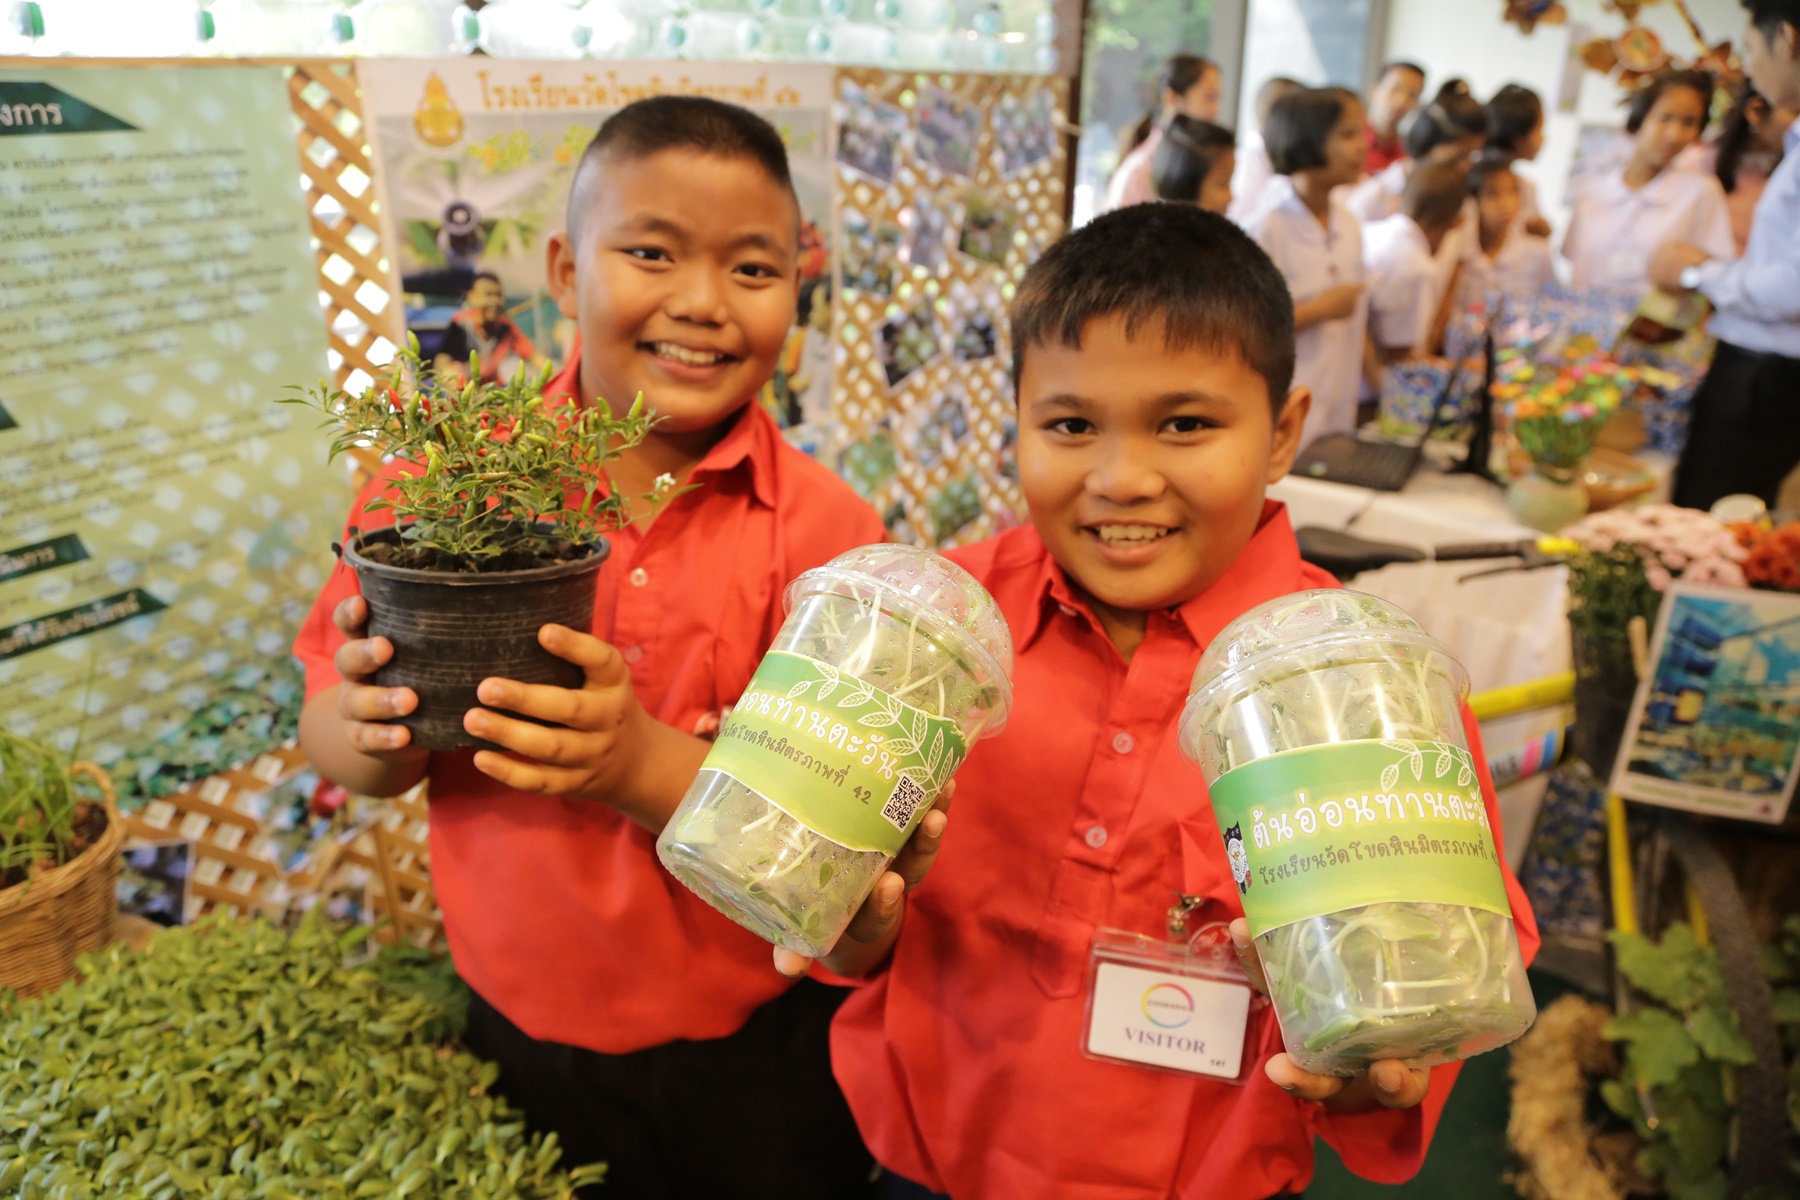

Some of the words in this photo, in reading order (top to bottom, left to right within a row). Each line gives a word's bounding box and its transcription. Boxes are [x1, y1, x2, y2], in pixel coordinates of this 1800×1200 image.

[853, 785, 872, 805] 42
[1259, 833, 1488, 885] โรงเรียนวัดโขดหินมิตรภาพที่
[1125, 1027, 1206, 1054] VISITOR
